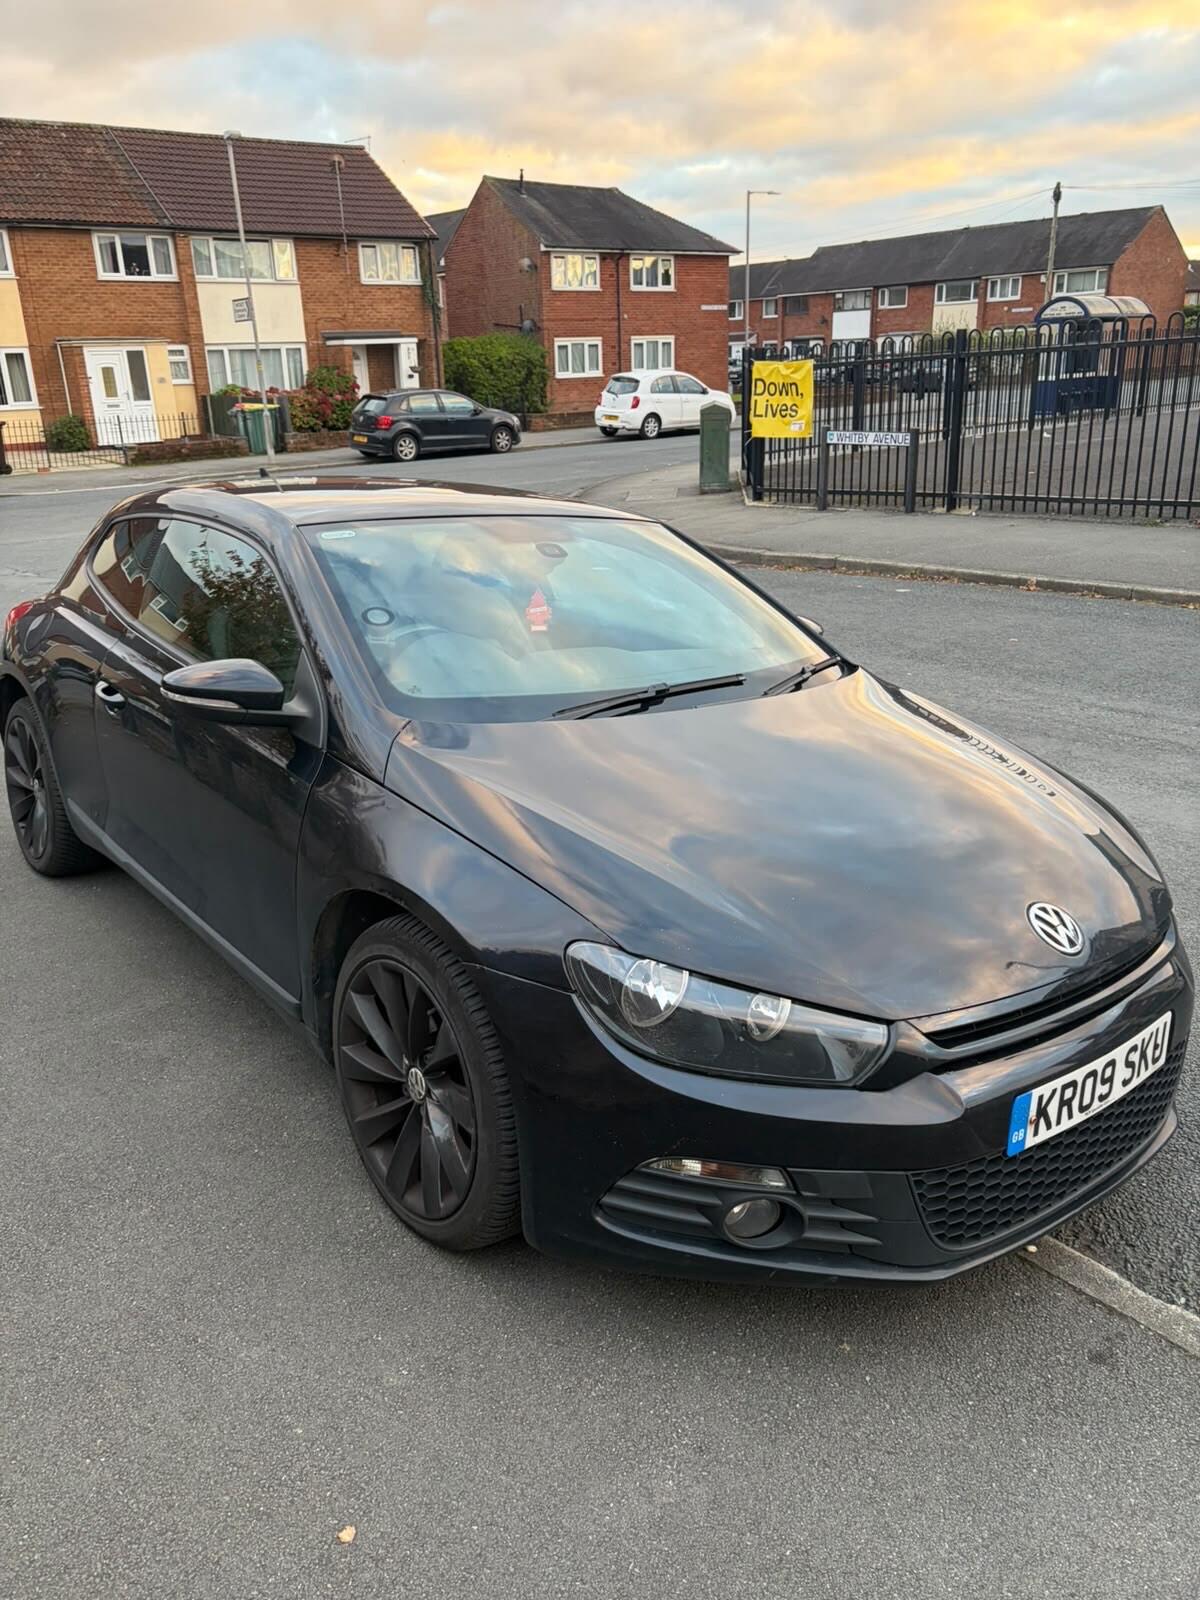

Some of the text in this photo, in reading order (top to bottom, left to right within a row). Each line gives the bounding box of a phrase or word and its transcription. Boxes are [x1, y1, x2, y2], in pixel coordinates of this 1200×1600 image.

[753, 378, 804, 399] Down,
[753, 399, 798, 418] Lives
[836, 432, 910, 445] WHITBY AVENUE
[1033, 1021, 1168, 1137] KR09 SKU
[1012, 1128, 1025, 1143] GB
